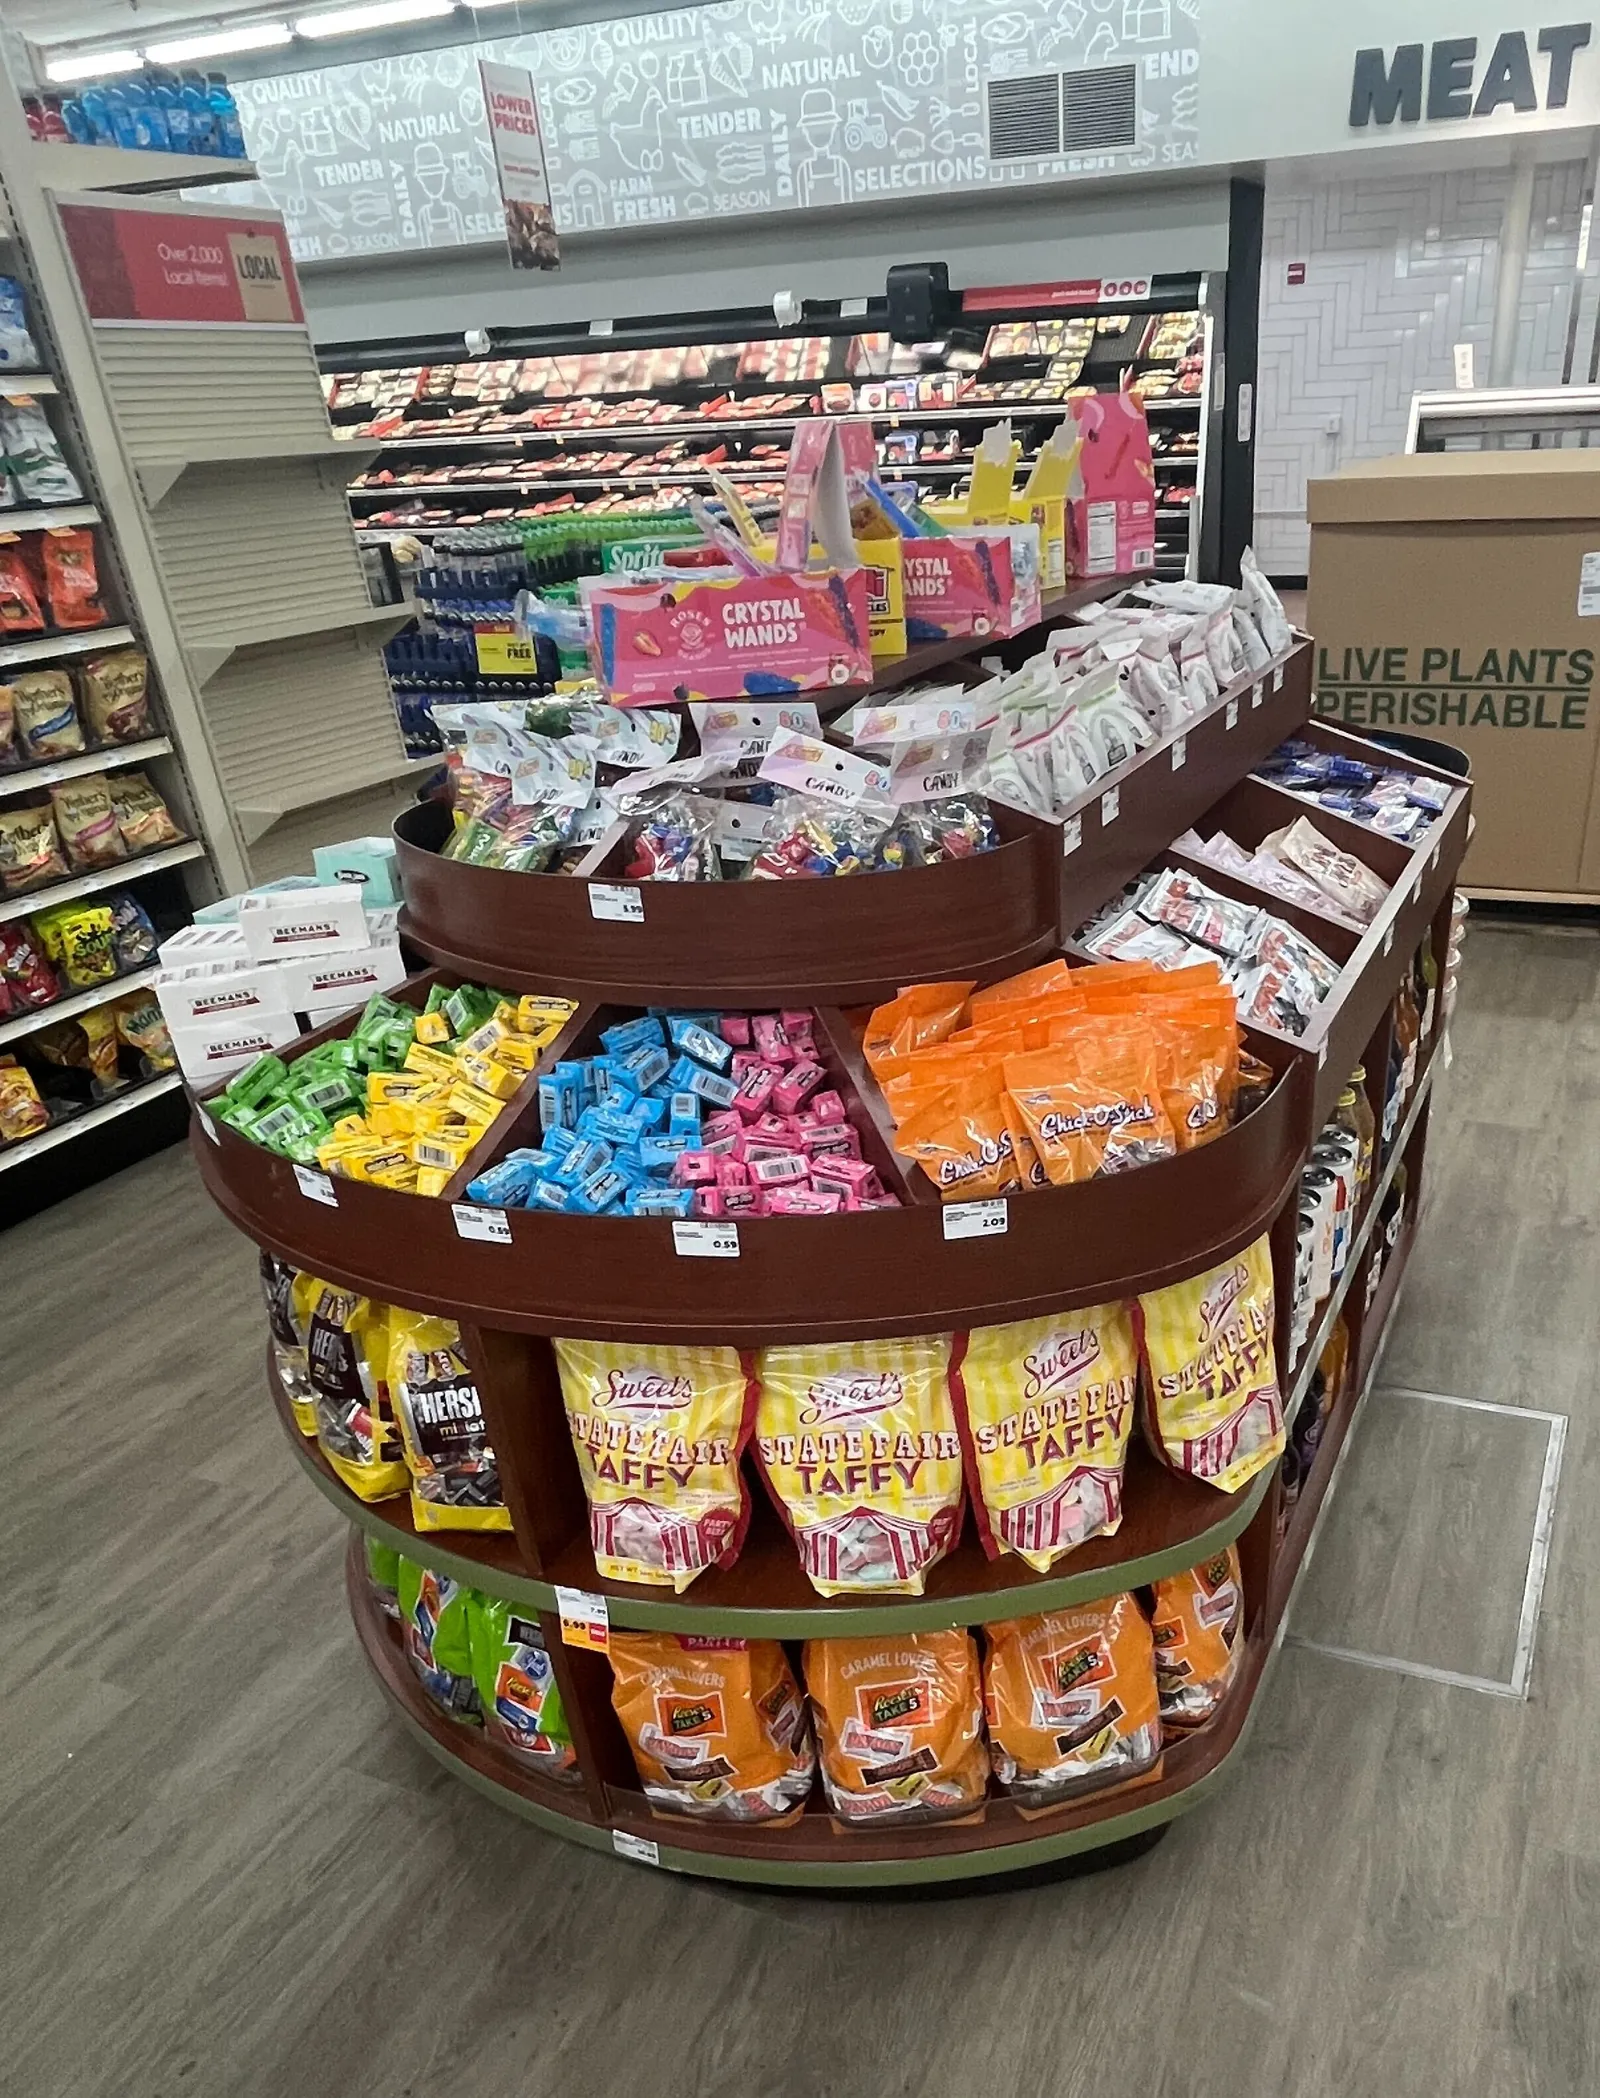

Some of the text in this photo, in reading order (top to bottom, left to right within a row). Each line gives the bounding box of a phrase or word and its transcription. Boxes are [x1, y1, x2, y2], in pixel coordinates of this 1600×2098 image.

[612, 11, 698, 47] QUALITY
[963, 17, 979, 93] LOCAL
[762, 53, 861, 90] NATURAL
[1349, 22, 1591, 127] MEAT
[252, 73, 325, 104] QUALITY
[491, 92, 531, 113] LOWER
[378, 112, 461, 143] NATURAL
[495, 112, 536, 135] PRICES
[678, 108, 762, 139] TENDER
[769, 108, 793, 197] DAILY
[314, 159, 384, 188] TENDER
[610, 175, 654, 197] FARM
[855, 156, 986, 192] SELECTIONS
[389, 160, 417, 239] DAILY
[613, 196, 677, 223] FRESH
[713, 189, 772, 213] SEASON
[351, 232, 400, 249] SEASON
[162, 265, 194, 285] Local
[237, 254, 282, 281] LOCAL
[905, 557, 952, 577] YSTAL
[904, 577, 945, 596] ANDS
[722, 598, 805, 626] CRYSTAL
[724, 622, 798, 649] WANDS
[507, 649, 532, 660] FREE
[1319, 647, 1594, 685] LIVE PLANTS
[1316, 691, 1590, 730] PERISHABLE
[805, 776, 855, 800] CANDY
[923, 771, 960, 792] CANDY
[276, 923, 331, 936] BEEMANS
[315, 968, 369, 983] BEEMANS
[195, 991, 251, 1007] BEEMANS
[209, 1036, 265, 1052] BEEMANS
[983, 1217, 1006, 1227] 2.09
[713, 1240, 737, 1249] 0.59
[1023, 1329, 1100, 1399] Sweet's
[592, 1369, 693, 1409] Sweet's
[976, 1375, 1137, 1455] STATE FAI
[759, 1429, 961, 1466] STATE FAIR
[1018, 1406, 1125, 1469] TAFFY
[586, 1443, 696, 1489] TAFFY
[795, 1461, 922, 1496] TAFFY
[1065, 1612, 1106, 1630] LOVERS
[687, 1670, 725, 1689] LOVERS
[840, 1652, 891, 1680] CARAMEL
[875, 1698, 919, 1723] TAKE 5
